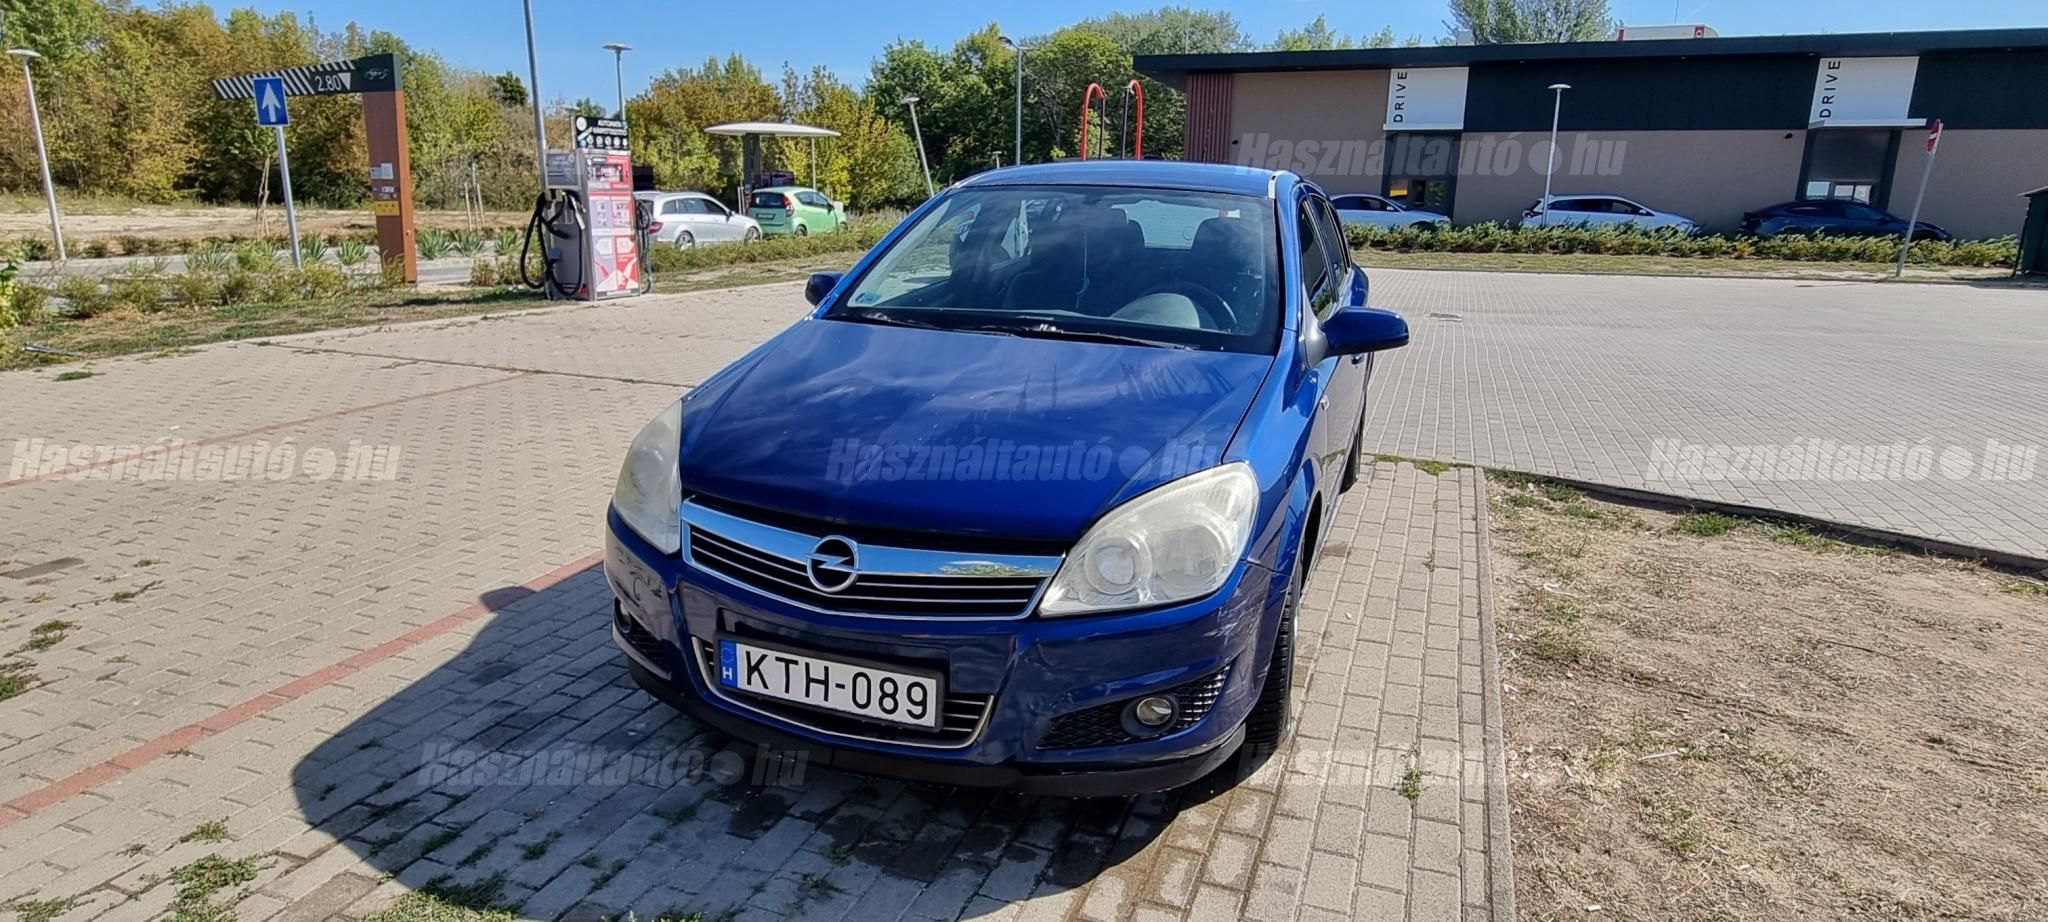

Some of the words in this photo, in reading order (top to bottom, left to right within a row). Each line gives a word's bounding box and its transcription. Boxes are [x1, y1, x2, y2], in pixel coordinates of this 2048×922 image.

[314, 75, 341, 92] 2.80
[1393, 71, 1408, 123] DRIVE
[1820, 60, 1840, 118] DRIVE
[722, 666, 733, 681] H
[745, 650, 928, 720] KTH-089
